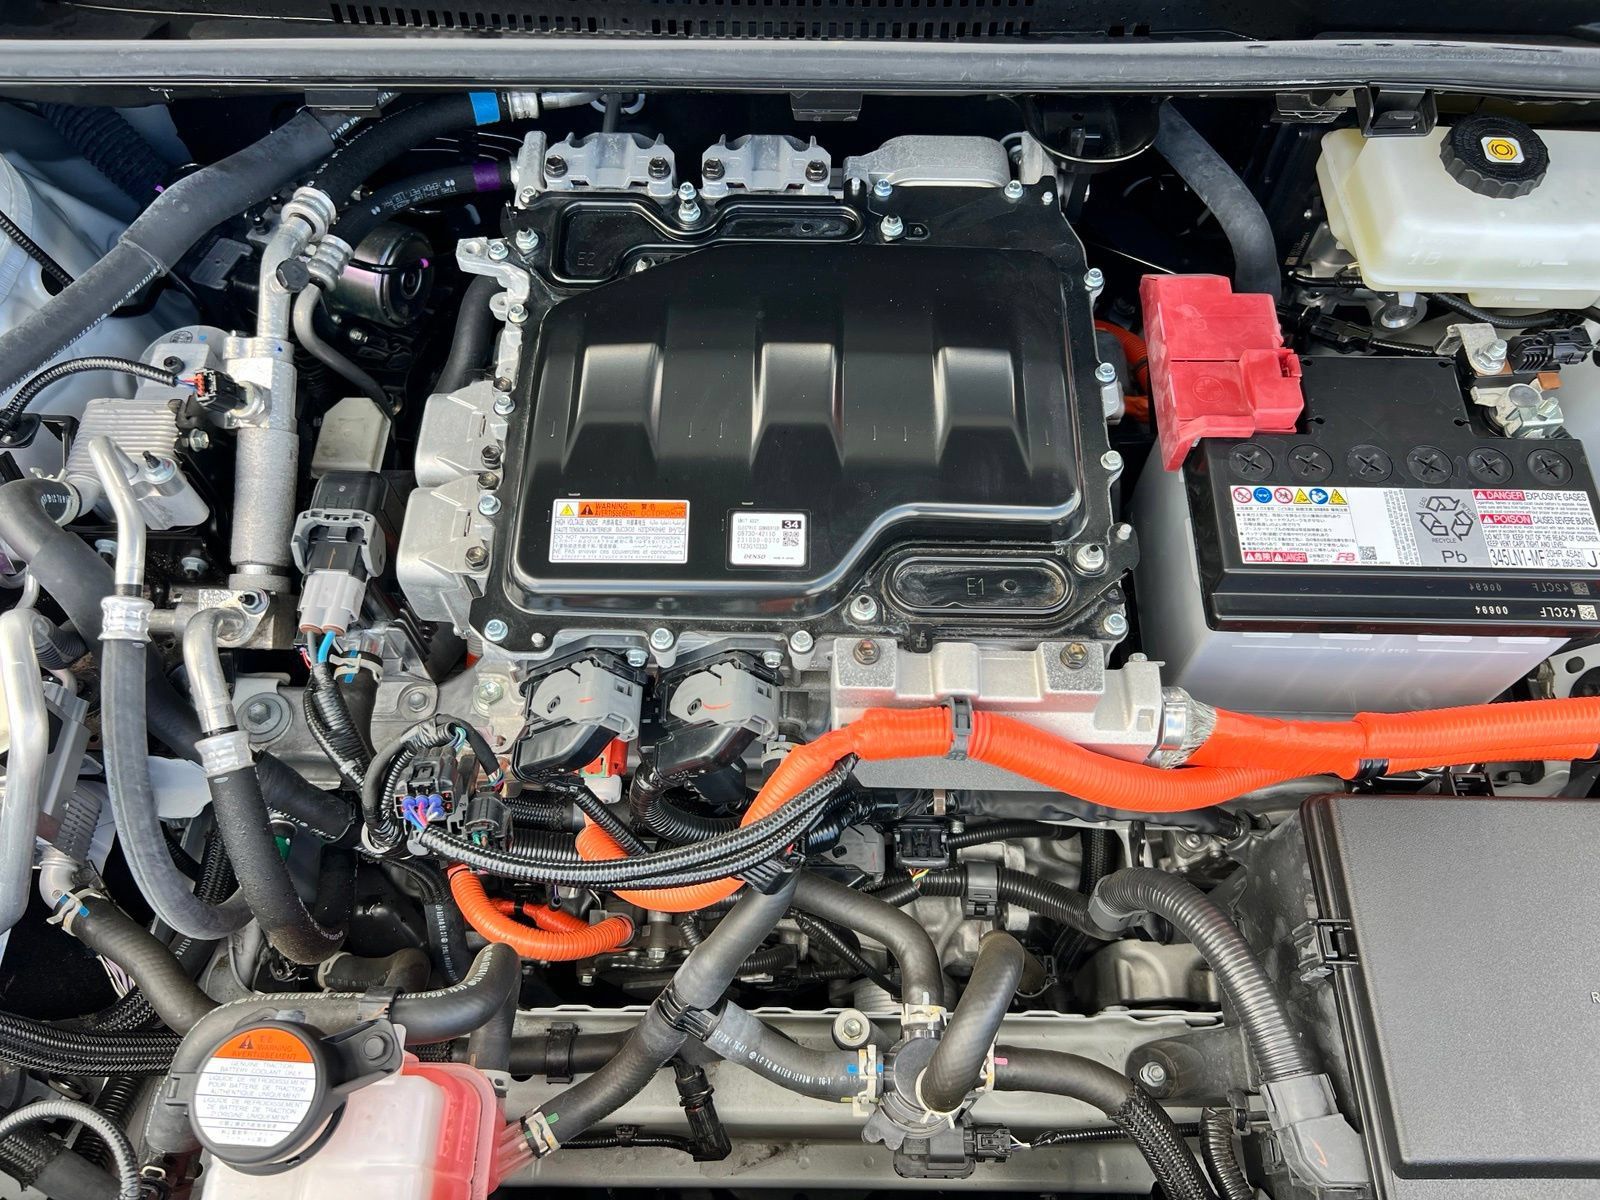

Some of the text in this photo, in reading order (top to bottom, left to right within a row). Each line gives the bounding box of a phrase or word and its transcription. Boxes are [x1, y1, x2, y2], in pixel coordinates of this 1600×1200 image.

[1487, 491, 1587, 501] DANGER EXPLOSIVE GASES
[784, 520, 799, 529] 34
[1533, 516, 1554, 524] CAUSES
[1555, 516, 1575, 525] SEVERE
[1576, 517, 1594, 525] BURNS
[1254, 553, 1272, 562] 危険
[1282, 553, 1306, 562] DANGER
[1442, 550, 1468, 564] Pb
[1490, 549, 1545, 566] 345LN1-MF
[966, 577, 985, 596] E1
[1540, 606, 1576, 618] 42CLF
[257, 1044, 293, 1052] WARNING
[232, 1050, 296, 1060] AVERTISSEMENT
